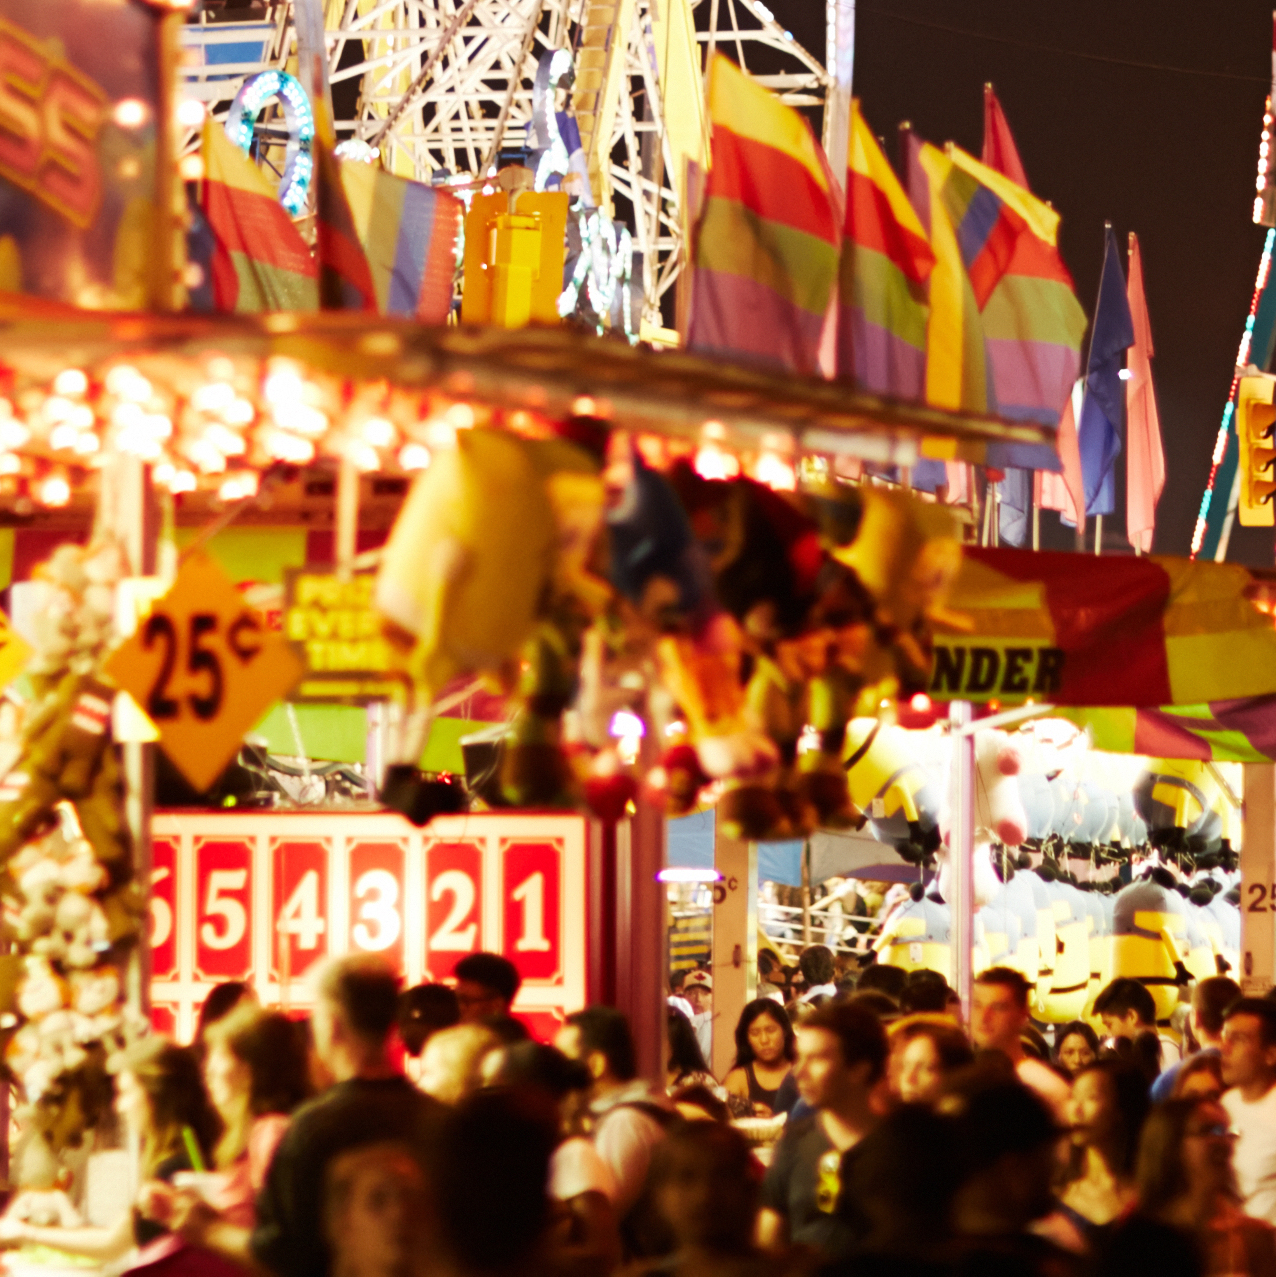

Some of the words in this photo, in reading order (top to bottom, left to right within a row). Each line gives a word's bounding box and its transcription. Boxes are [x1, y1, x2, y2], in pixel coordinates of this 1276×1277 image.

[144, 614, 263, 720] 25¢
[201, 869, 248, 950] 5
[278, 870, 325, 950] 4
[353, 869, 402, 951] 3
[430, 869, 478, 951] 2
[512, 871, 551, 951] 1
